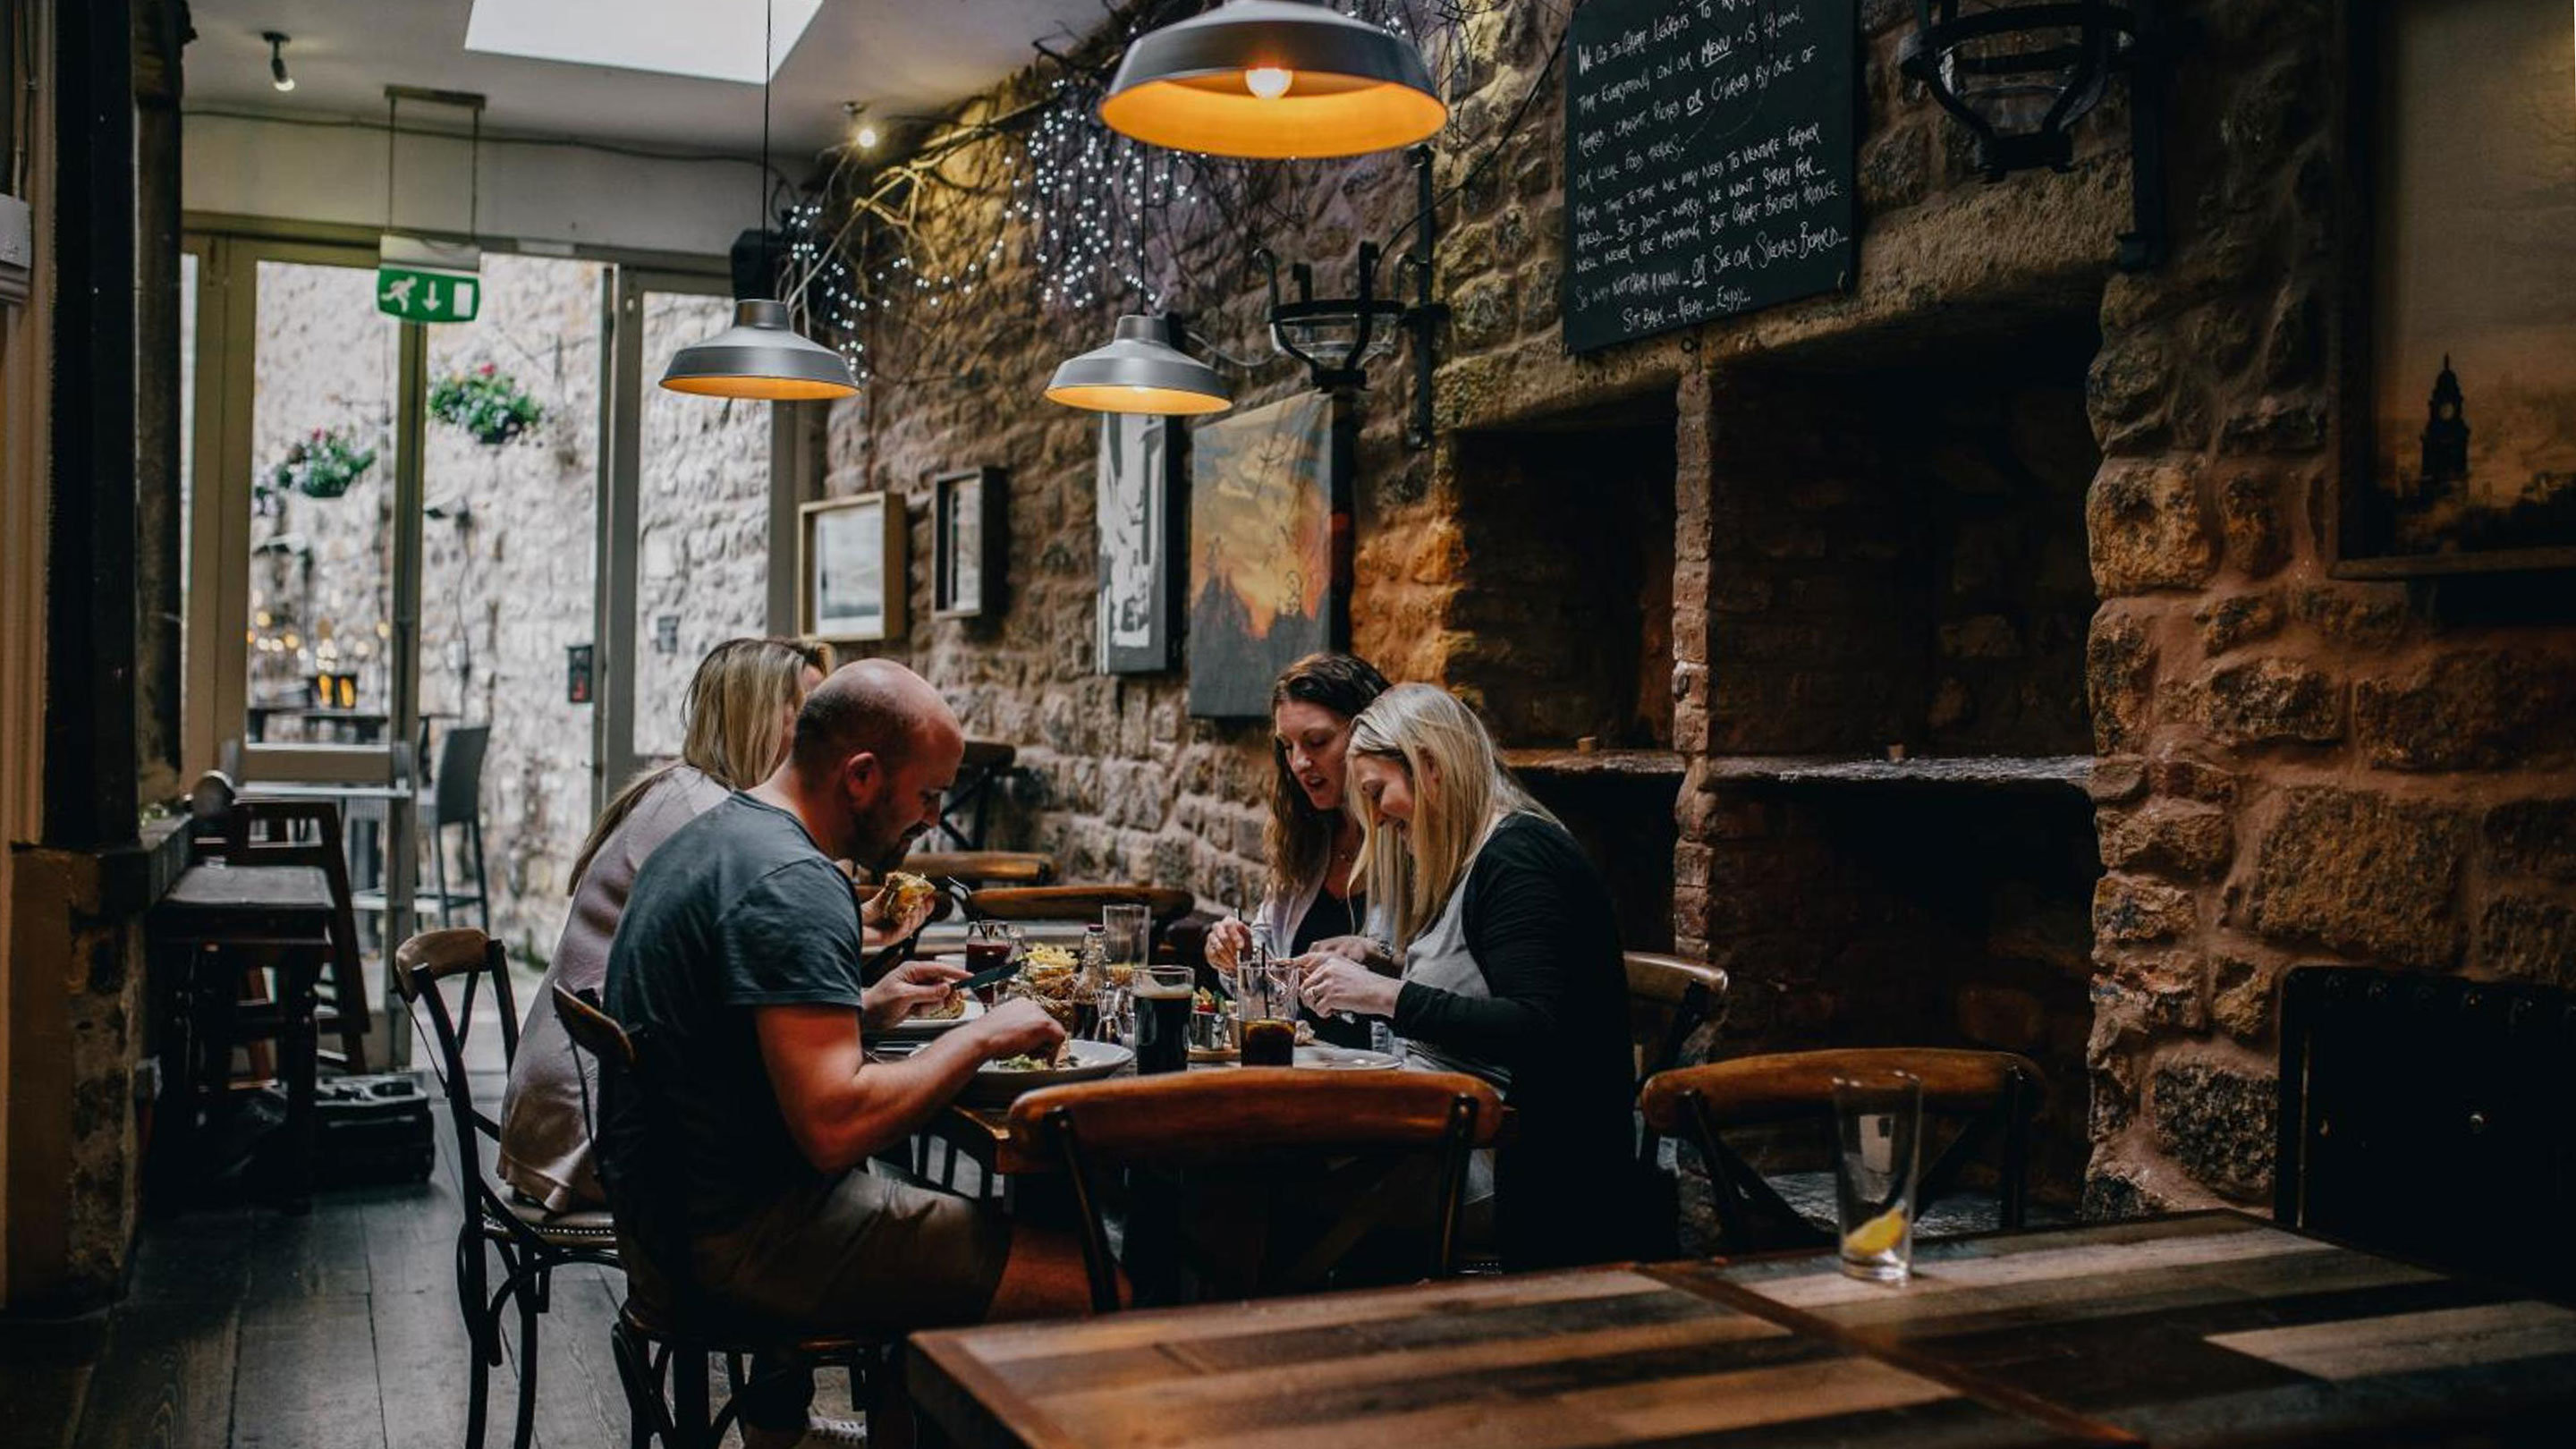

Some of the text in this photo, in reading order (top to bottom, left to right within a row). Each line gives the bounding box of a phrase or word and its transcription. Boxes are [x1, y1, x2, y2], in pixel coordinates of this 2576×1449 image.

[1696, 0, 1711, 18] TO
[1657, 55, 1672, 79] ON
[1686, 88, 1704, 116] OR
[1773, 55, 1794, 78] ONE
[1801, 45, 1817, 64] OF
